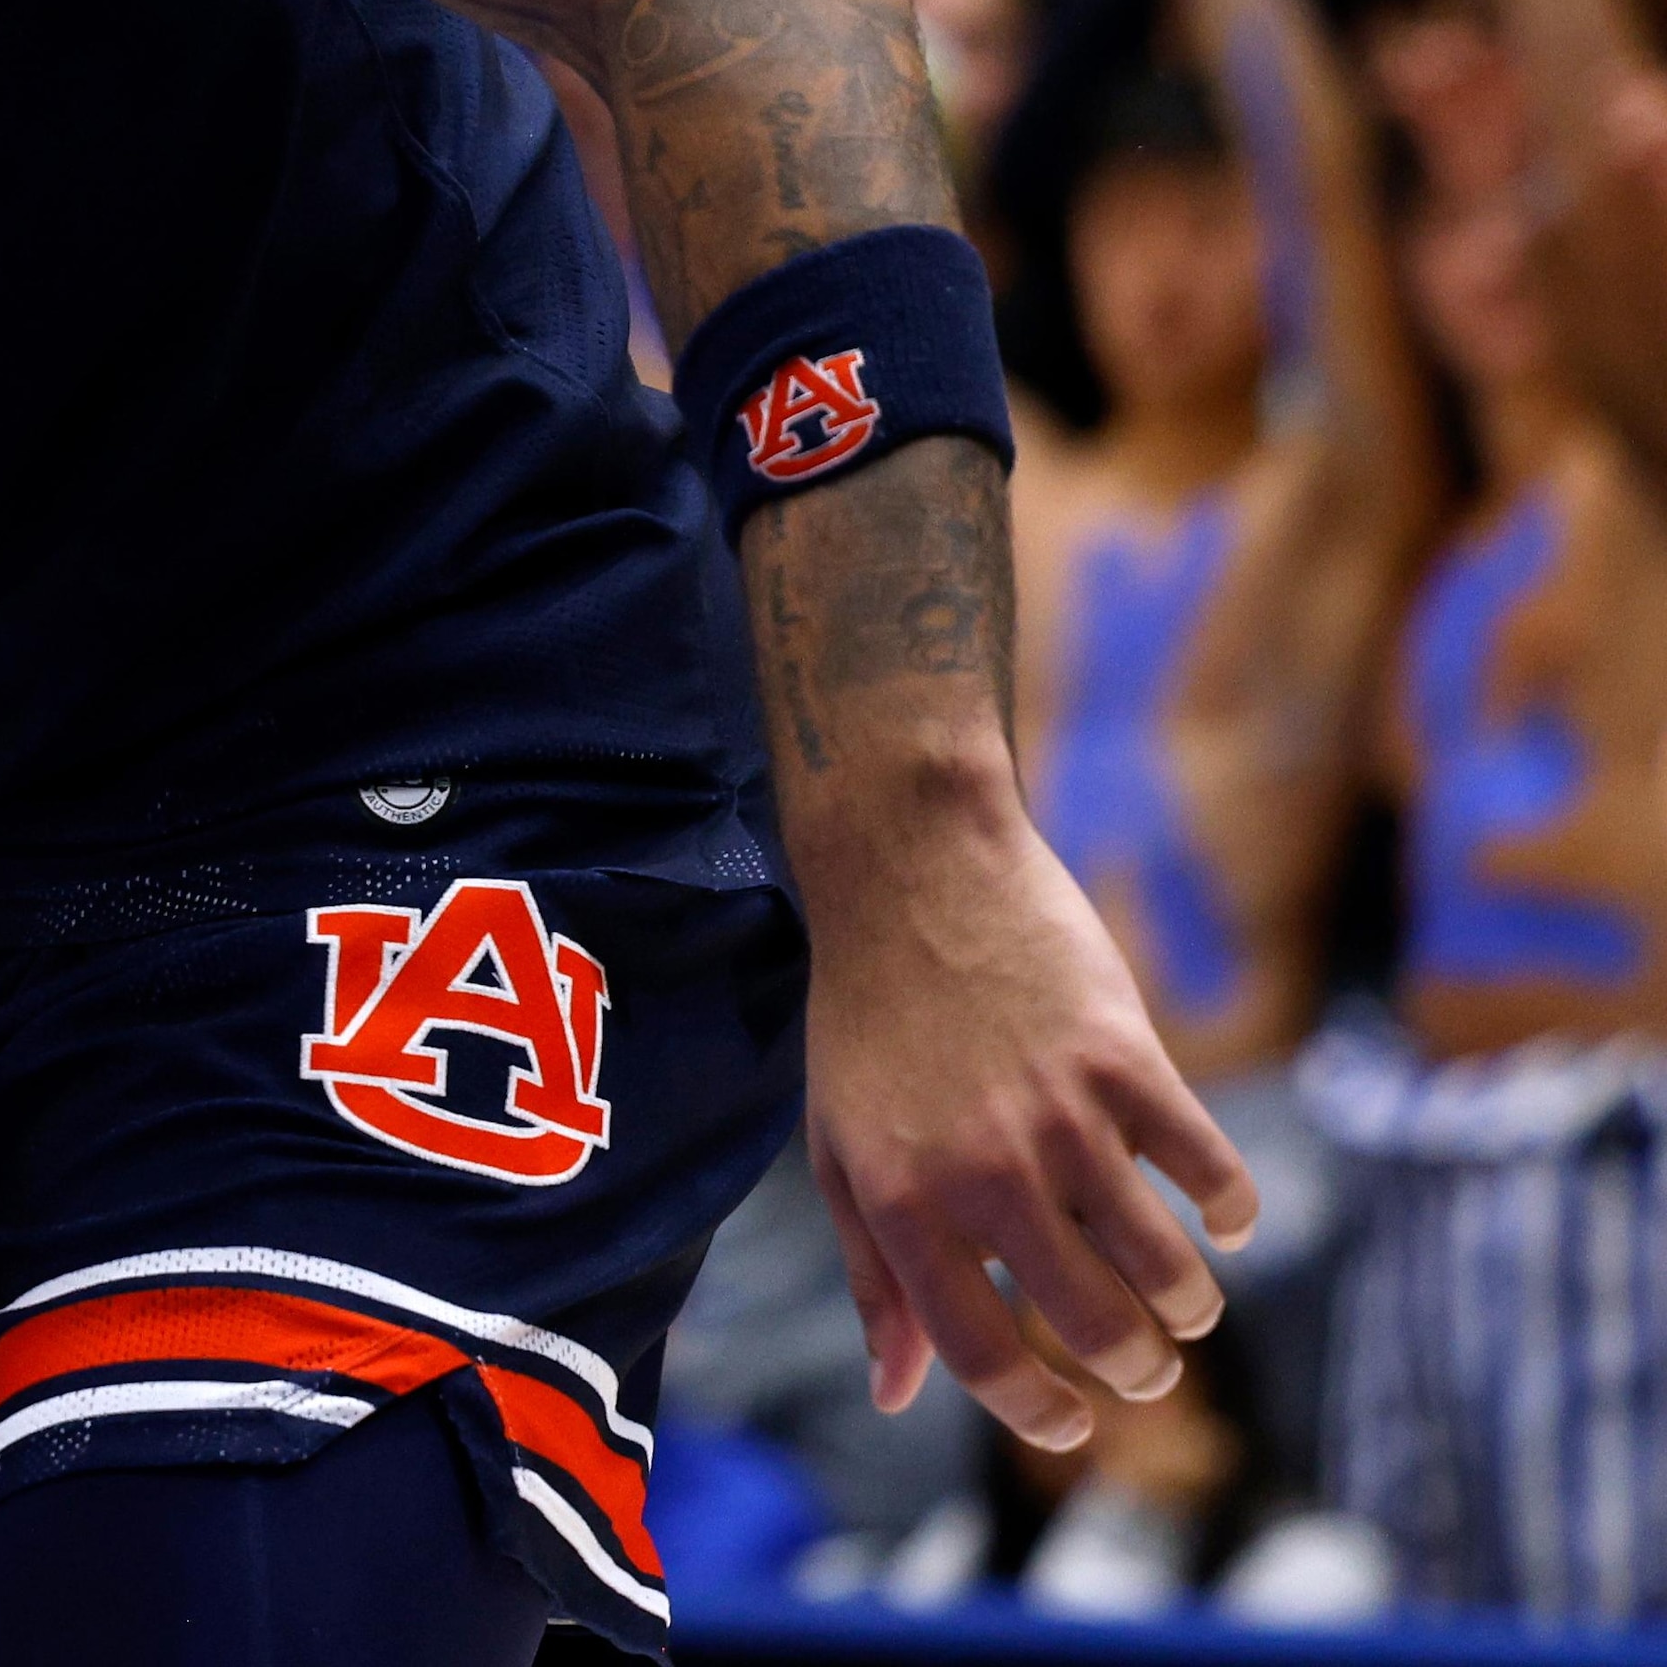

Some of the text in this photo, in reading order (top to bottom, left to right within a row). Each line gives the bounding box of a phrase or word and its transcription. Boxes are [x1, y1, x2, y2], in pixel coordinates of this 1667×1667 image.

[736, 347, 882, 483] AU
[365, 794, 442, 823] AUTHENTIC
[300, 878, 612, 1187] AU
